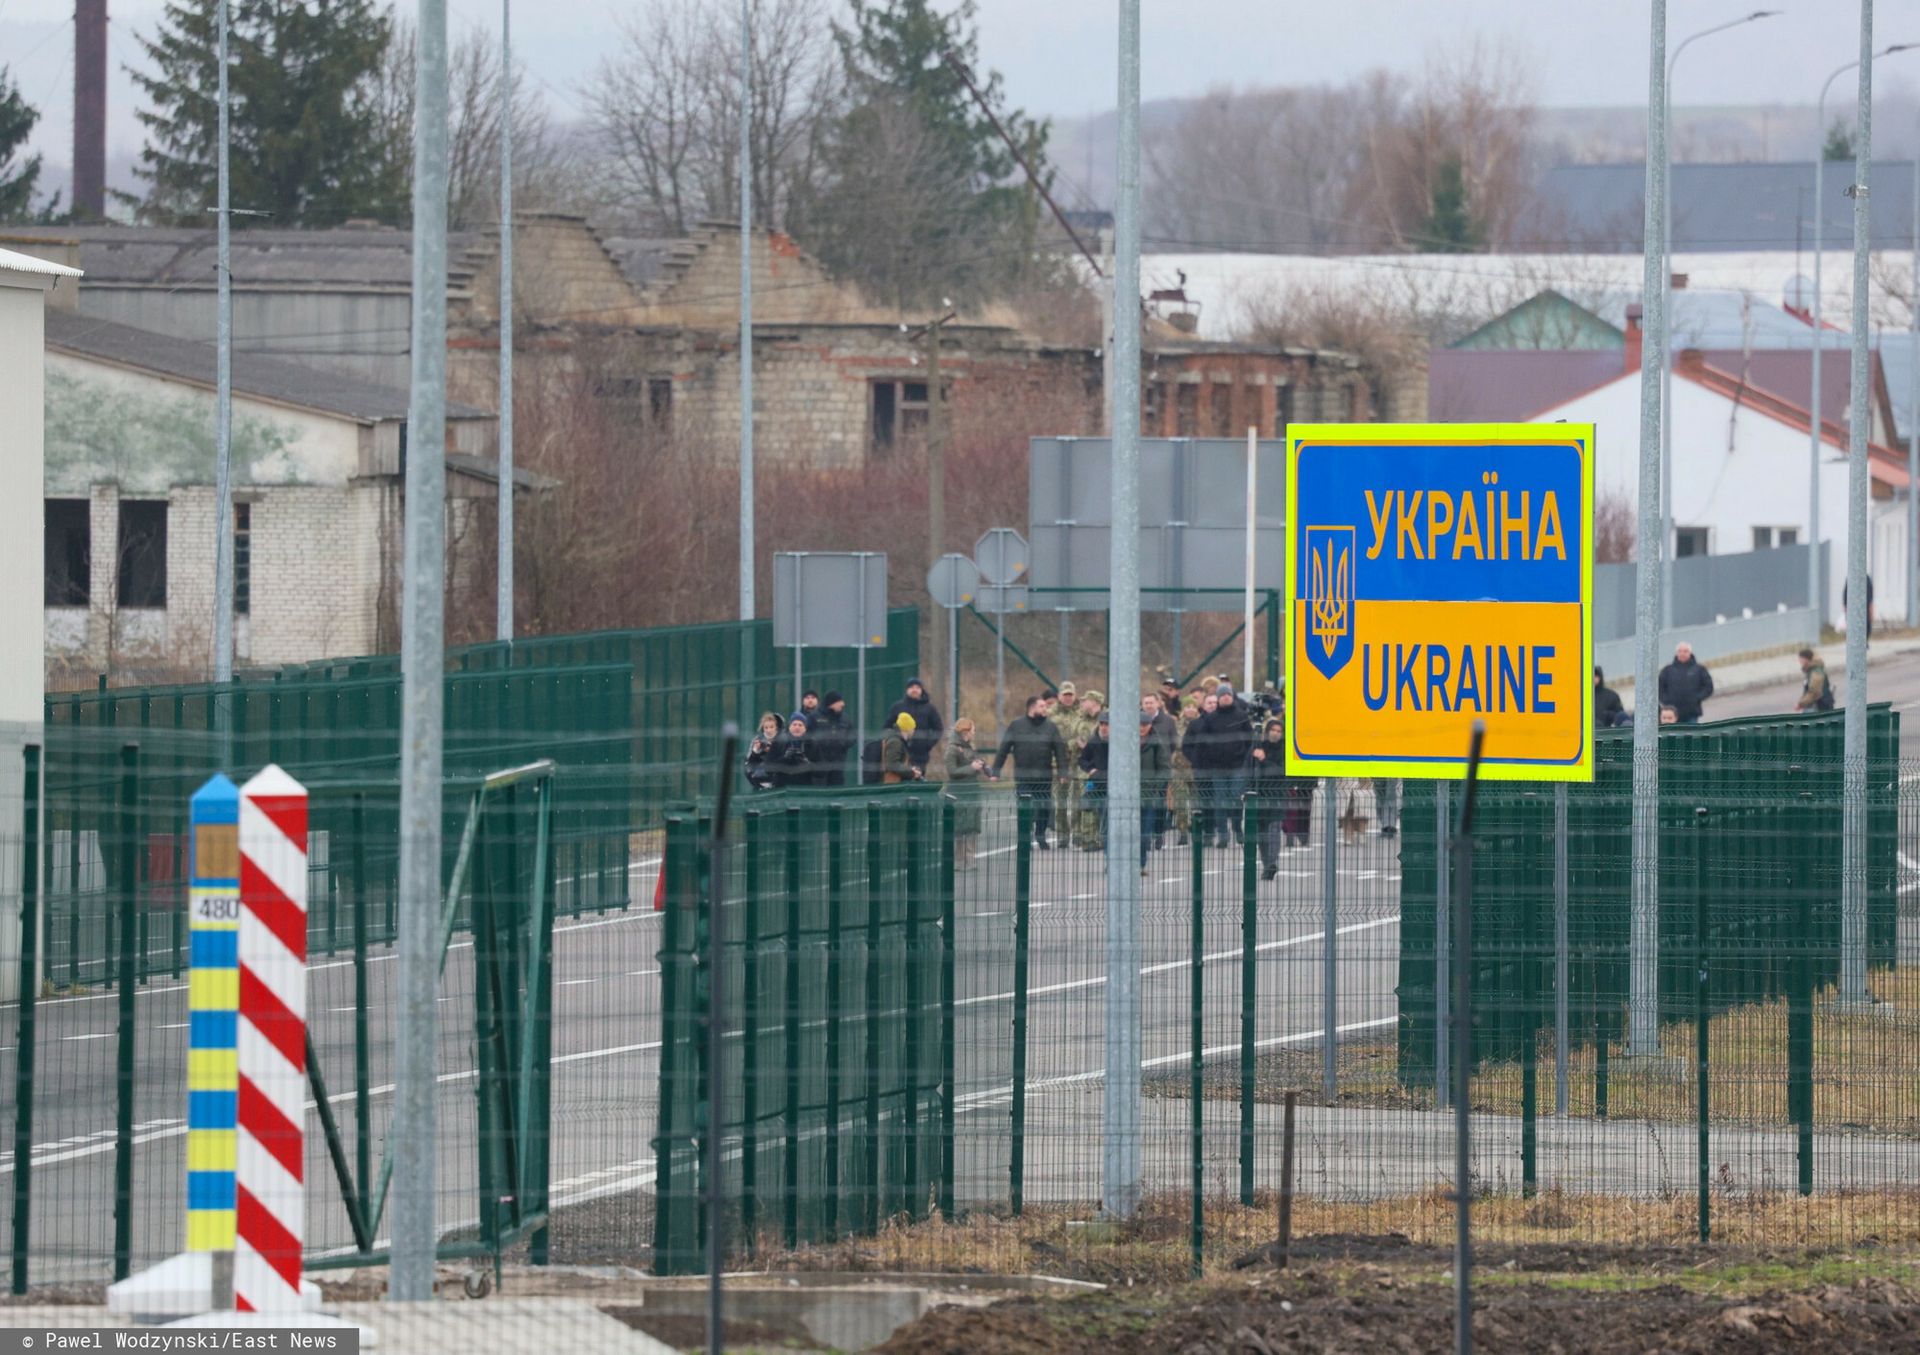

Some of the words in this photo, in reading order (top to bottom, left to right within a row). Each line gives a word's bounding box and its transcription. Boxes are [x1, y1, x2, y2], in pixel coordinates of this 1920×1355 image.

[1364, 471, 1567, 561] УКРАЇНА
[1362, 643, 1556, 714] UKRAINE
[198, 898, 239, 919] 480
